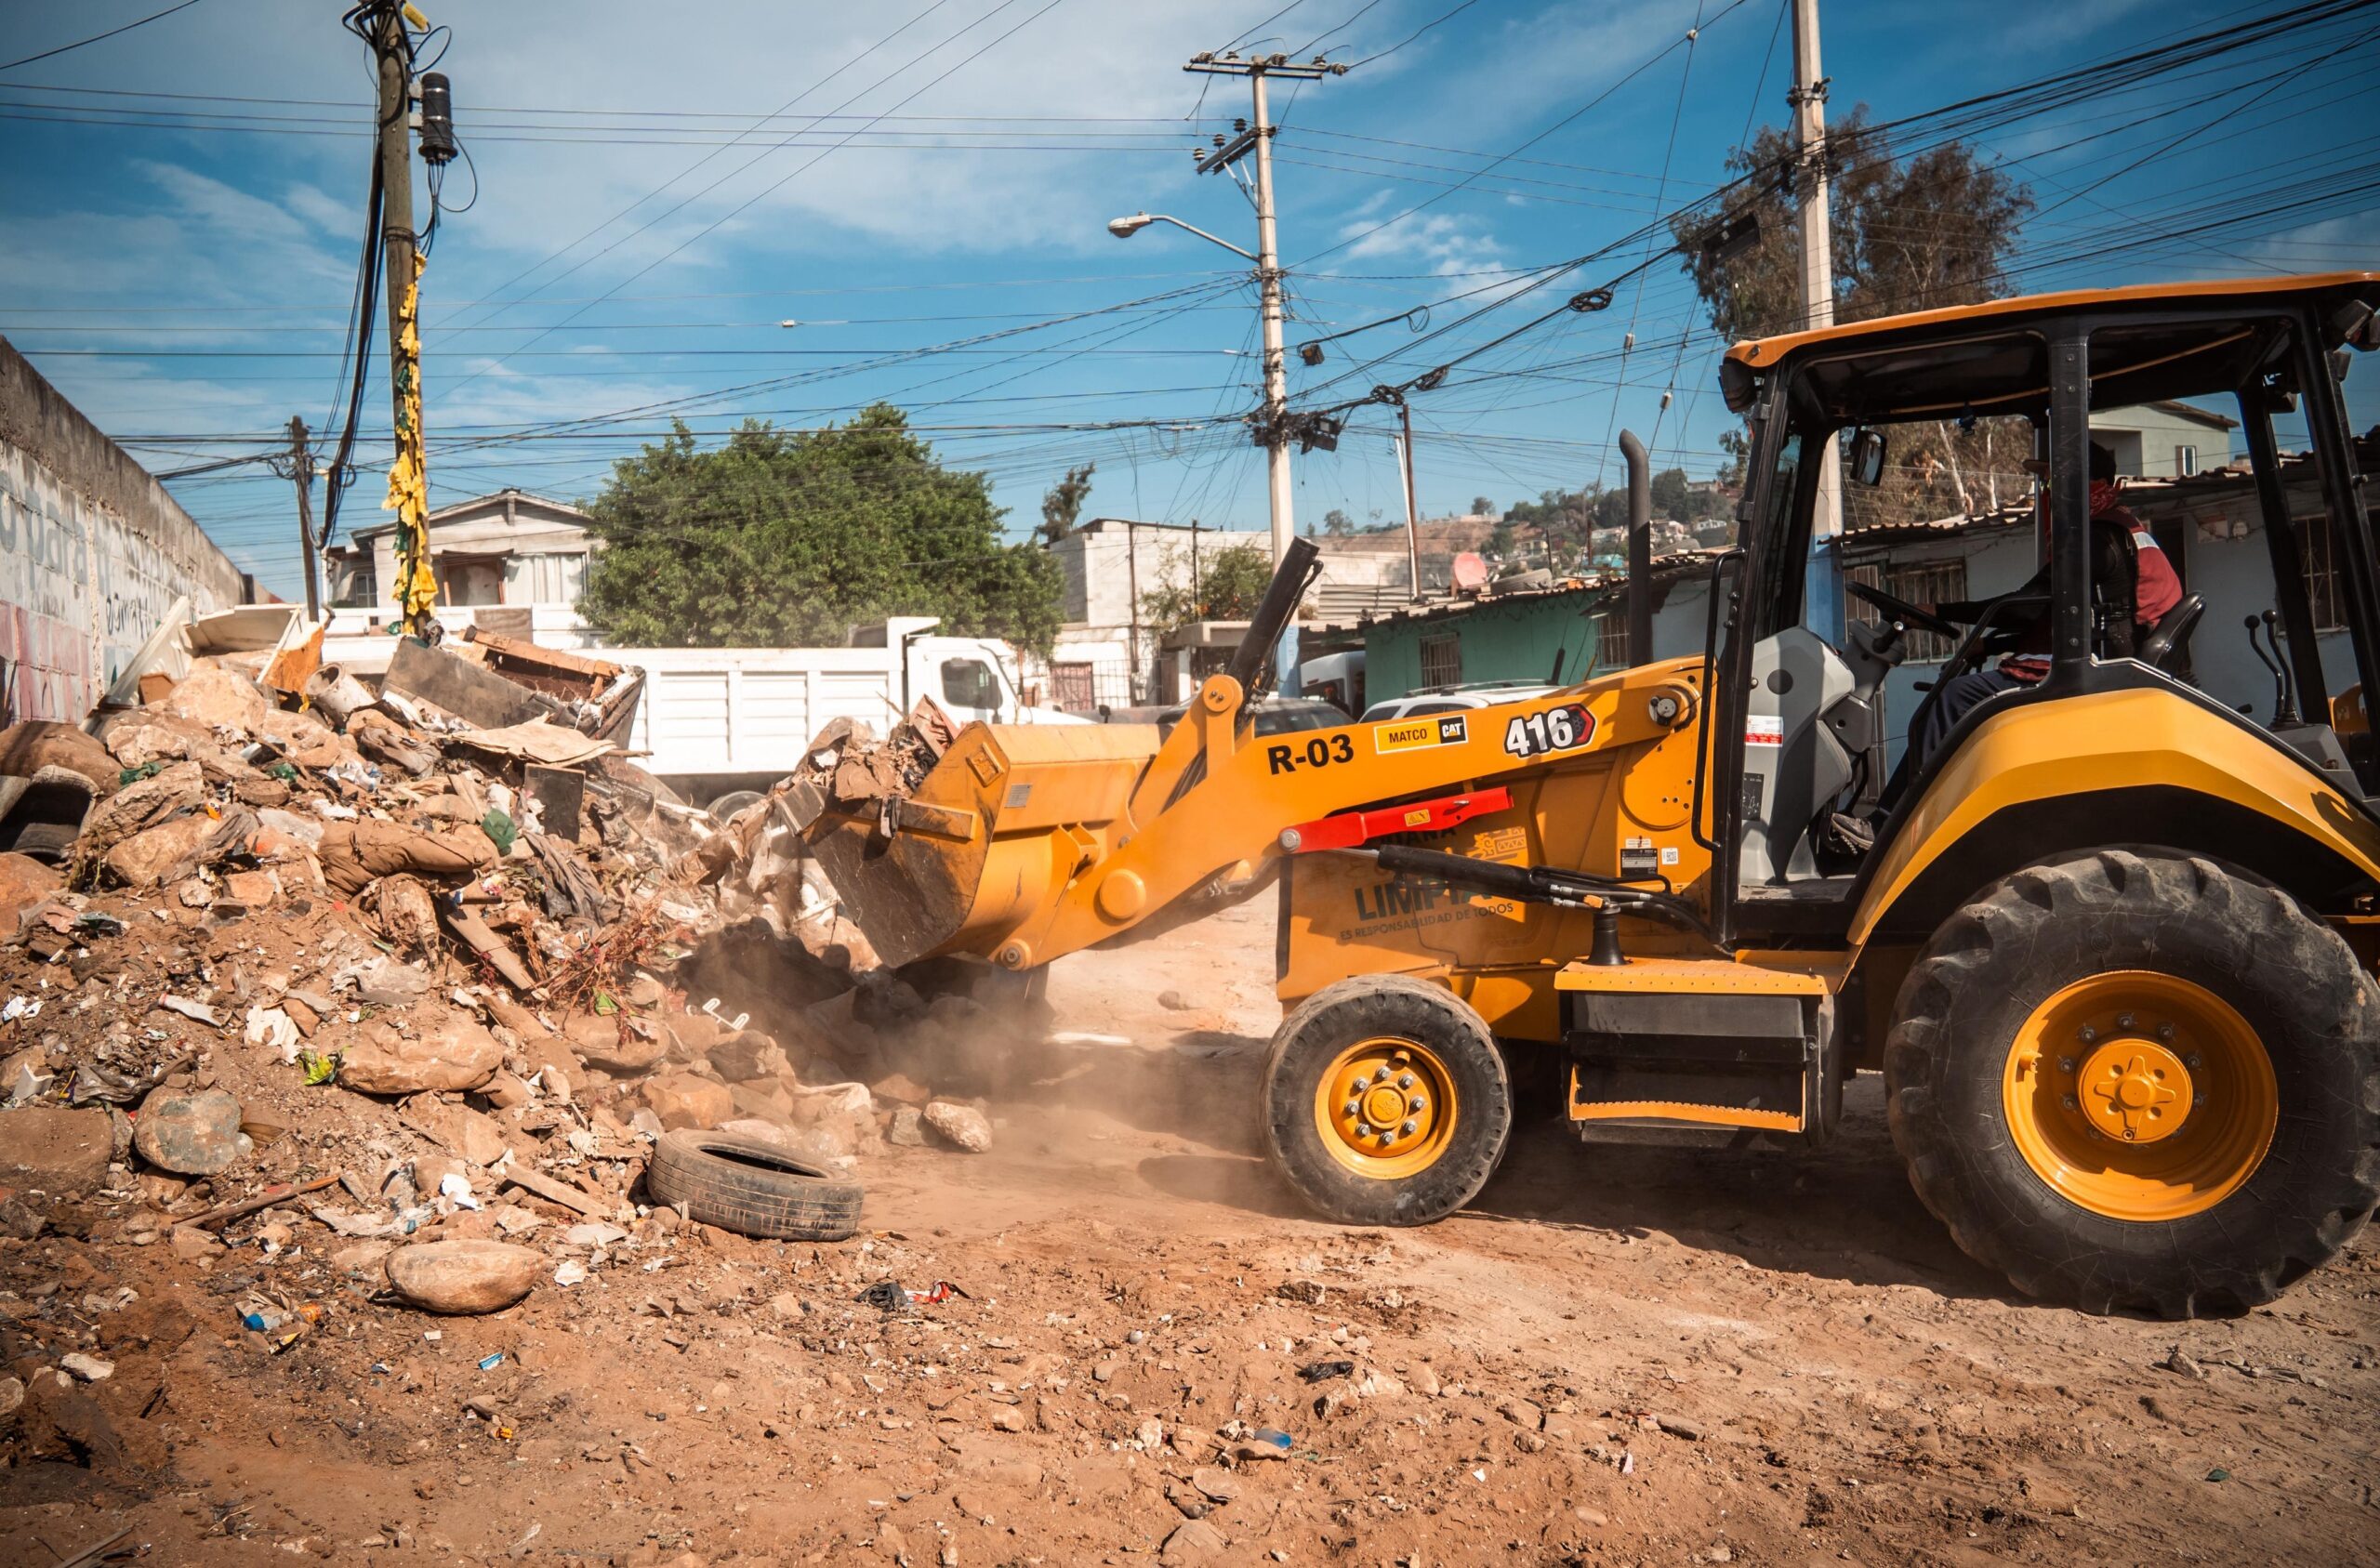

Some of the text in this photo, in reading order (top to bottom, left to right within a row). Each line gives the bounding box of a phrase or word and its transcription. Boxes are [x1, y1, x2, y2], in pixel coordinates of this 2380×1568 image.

[1389, 723, 1461, 744] MATCO CAT
[1507, 709, 1573, 755] 416
[1268, 733, 1354, 775] R-03
[1341, 929, 1353, 941] ES
[1456, 909, 1471, 921] DE
[1474, 902, 1514, 918] TODOS
